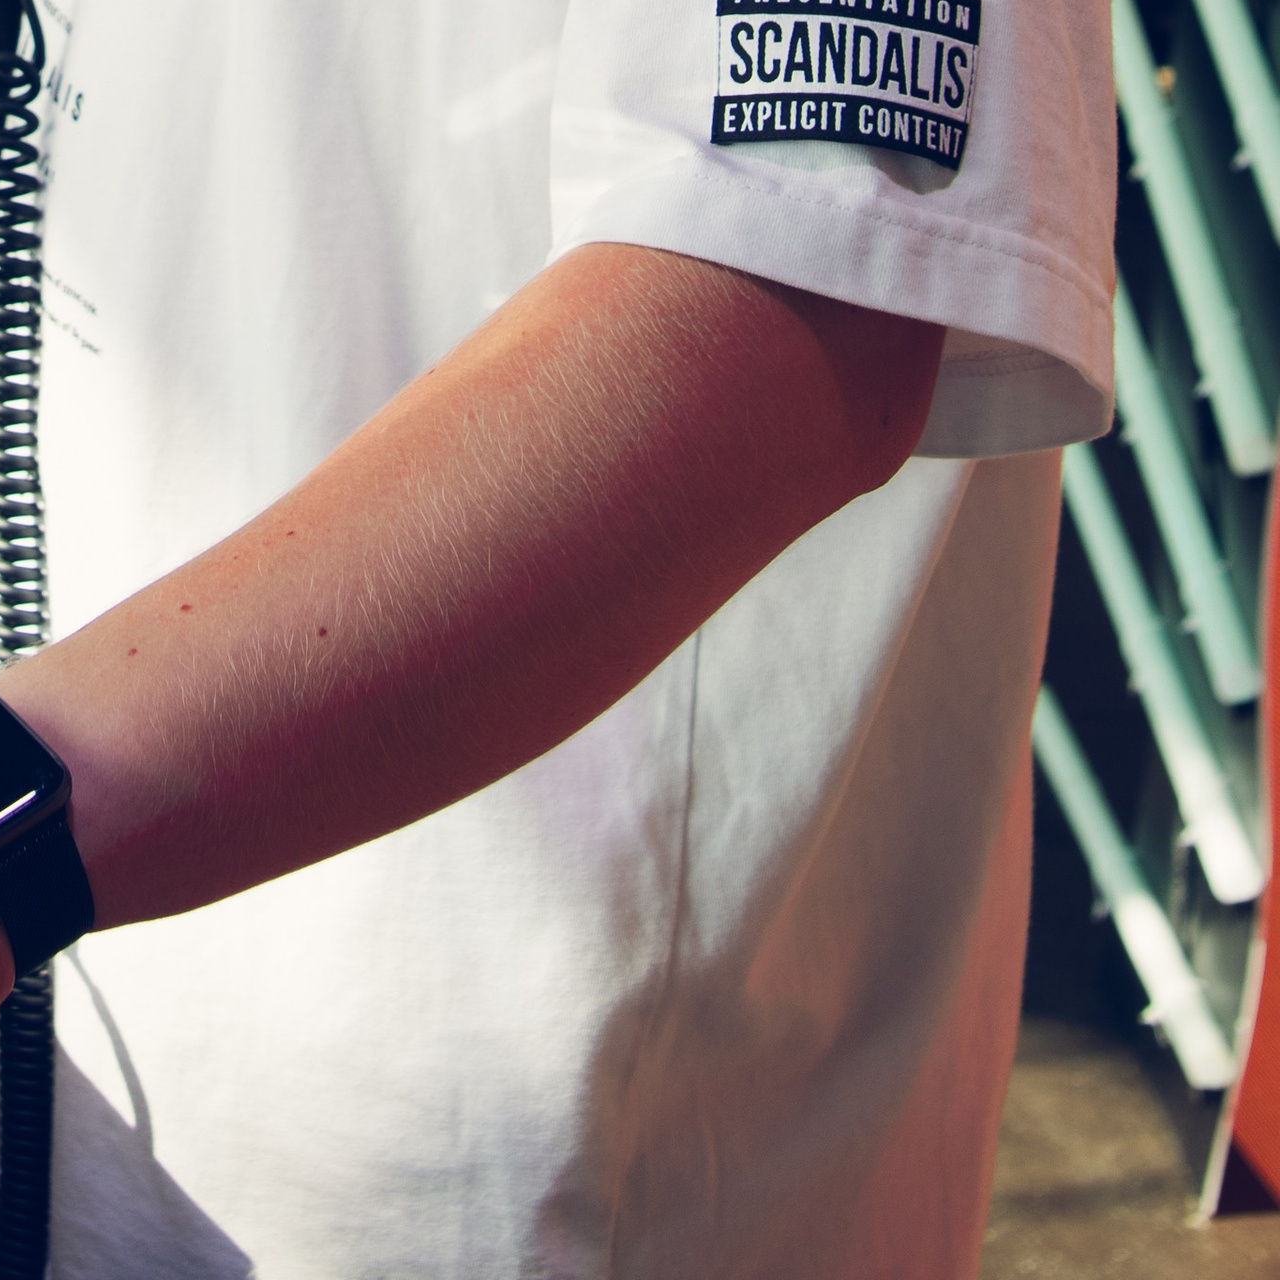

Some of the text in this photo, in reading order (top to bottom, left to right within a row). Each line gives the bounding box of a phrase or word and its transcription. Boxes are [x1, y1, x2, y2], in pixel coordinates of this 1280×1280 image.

[730, 20, 968, 109] SCANDALIS
[723, 100, 962, 159] EXPLICIT CONTENT
